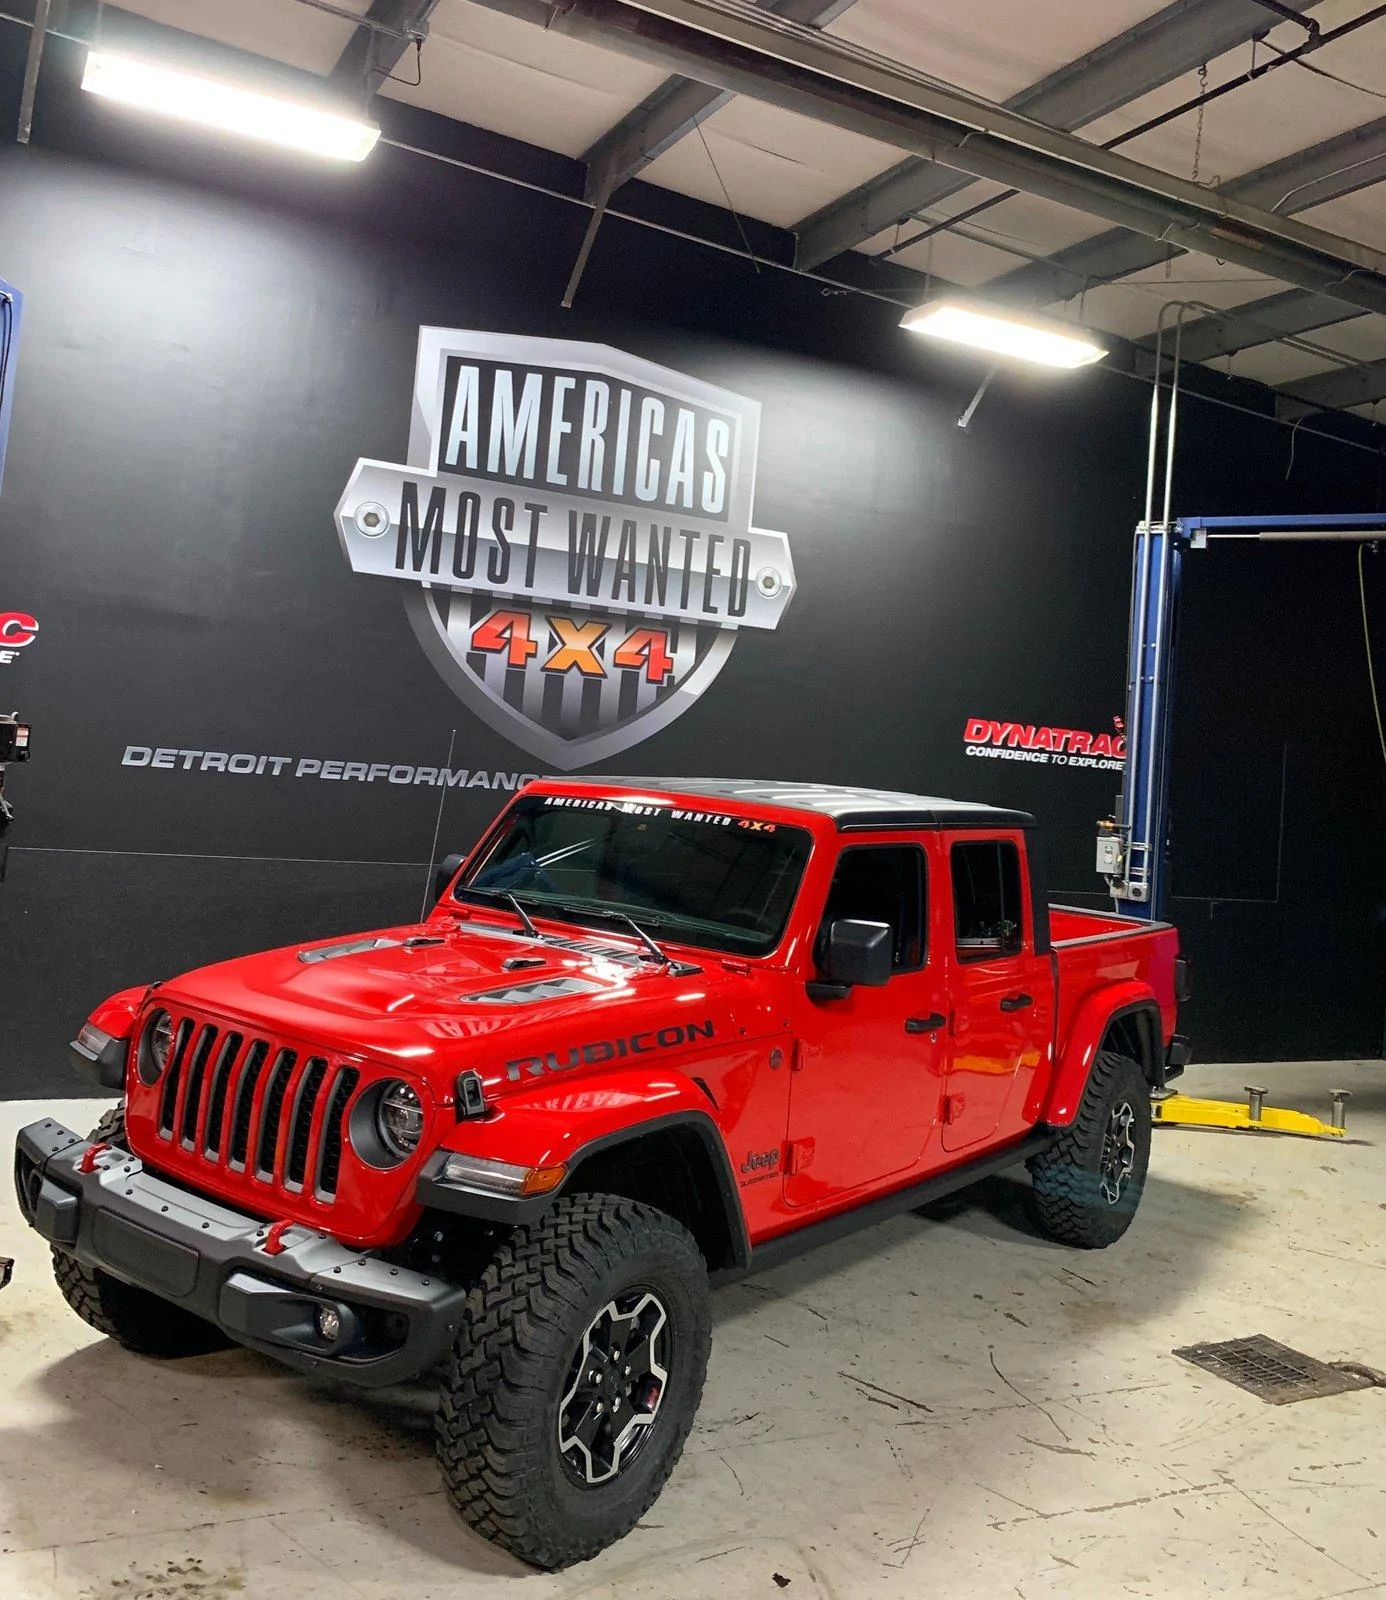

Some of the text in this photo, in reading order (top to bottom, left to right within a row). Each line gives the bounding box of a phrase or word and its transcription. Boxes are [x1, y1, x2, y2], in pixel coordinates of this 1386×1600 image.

[445, 366, 730, 514] AMERICAS
[395, 480, 752, 618] MOST WANTED
[470, 609, 675, 685] 4X4
[121, 745, 292, 776] DETROIT
[965, 745, 1124, 770] CONFIDENCE TO EXPLORE
[544, 797, 777, 834] AMERICAS MOST WANTED 4X4
[505, 1020, 715, 1082] RUBICON
[741, 1149, 780, 1174] Jeep
